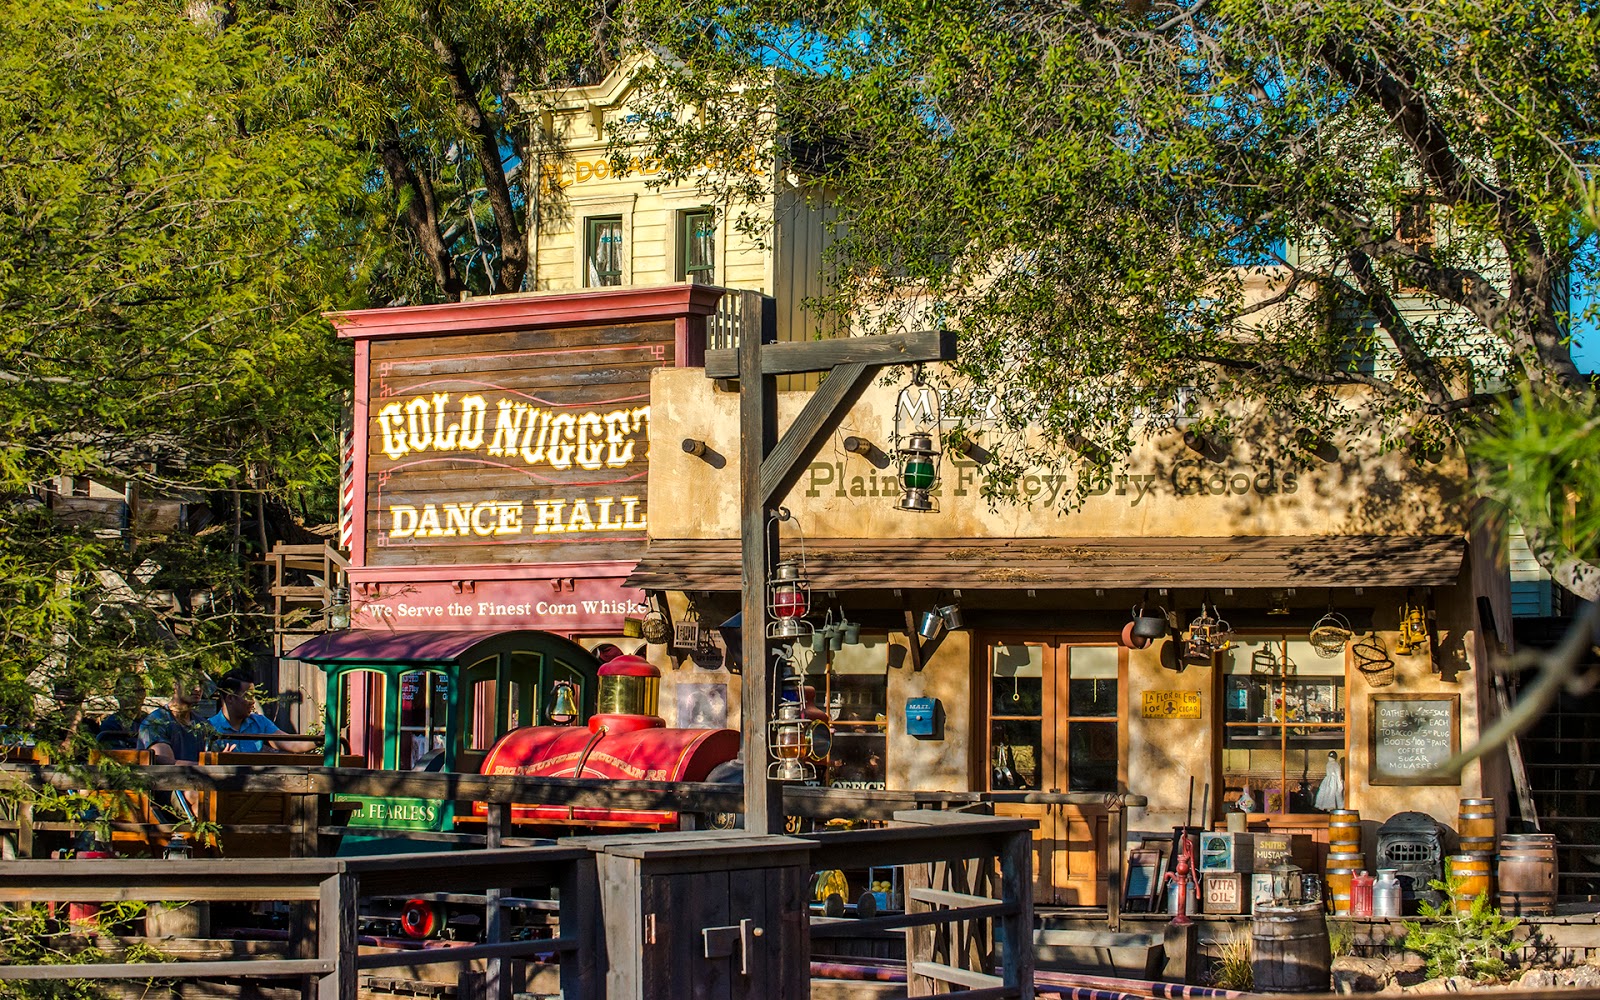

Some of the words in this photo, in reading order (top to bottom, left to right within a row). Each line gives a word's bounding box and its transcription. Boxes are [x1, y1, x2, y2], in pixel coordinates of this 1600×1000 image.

[376, 391, 488, 460] GOLD
[487, 398, 650, 470] NUGGET
[806, 461, 900, 498] Plain
[1171, 458, 1299, 496] Goods
[389, 500, 524, 538] DANCE
[533, 495, 647, 535] HALL
[398, 603, 443, 617] Serve
[447, 602, 473, 616] the
[478, 601, 531, 616] Finest
[536, 601, 577, 615] Corn
[1429, 718, 1449, 727] EACH
[1432, 739, 1449, 748] PAIR
[1397, 747, 1426, 755] COFFEE
[1397, 755, 1429, 763] SUGAR
[587, 751, 645, 779] MOUNTAIN
[645, 769, 667, 781] RR
[1389, 762, 1438, 770] MOLASSES
[369, 803, 435, 822] FEARLESS
[1260, 841, 1287, 850] SMITHS
[1209, 879, 1235, 891] VITA
